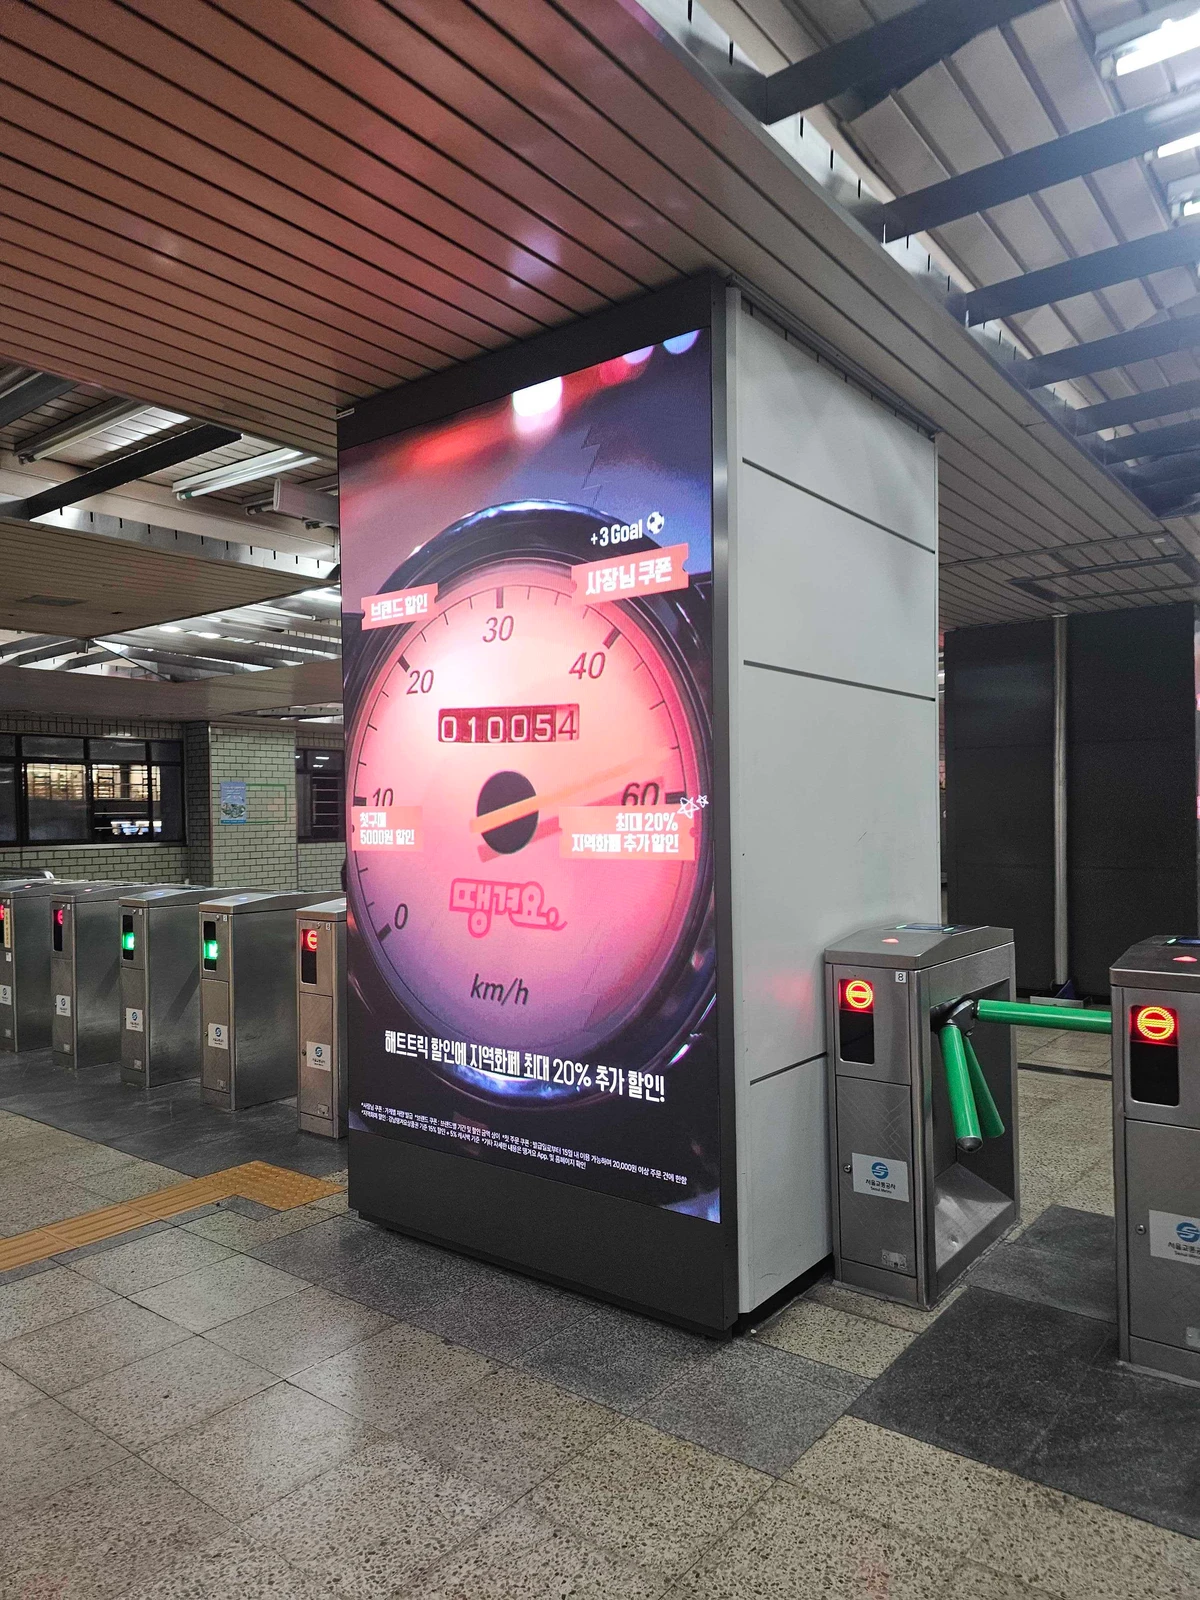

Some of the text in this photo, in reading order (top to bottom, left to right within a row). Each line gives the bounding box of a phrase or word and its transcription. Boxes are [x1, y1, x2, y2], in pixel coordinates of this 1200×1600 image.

[585, 557, 672, 596] 사장님 쿠폰
[371, 593, 428, 621] 브랜드 할인
[482, 615, 513, 642] 30
[569, 652, 606, 680] 40
[406, 669, 434, 695] 20
[441, 710, 577, 742] 010054
[372, 788, 394, 806] 10
[622, 782, 659, 806] 60
[616, 812, 678, 831] 최대 20%
[360, 829, 414, 845] 5000원 할인
[572, 834, 678, 852] 지역화폐 추가 할인
[395, 903, 408, 929] 0
[471, 974, 528, 1005] km/h
[898, 973, 904, 981] 8
[385, 1030, 665, 1102] 해트트릭 할인에 지역화폐 최대 20% 추가 할인!
[580, 1153, 590, 1162] 이용
[638, 1166, 649, 1176] 이상
[650, 1168, 662, 1179] 주문
[662, 1172, 674, 1182] 건에
[675, 1175, 687, 1185] 한함
[866, 1179, 896, 1190] 서울교통공사
